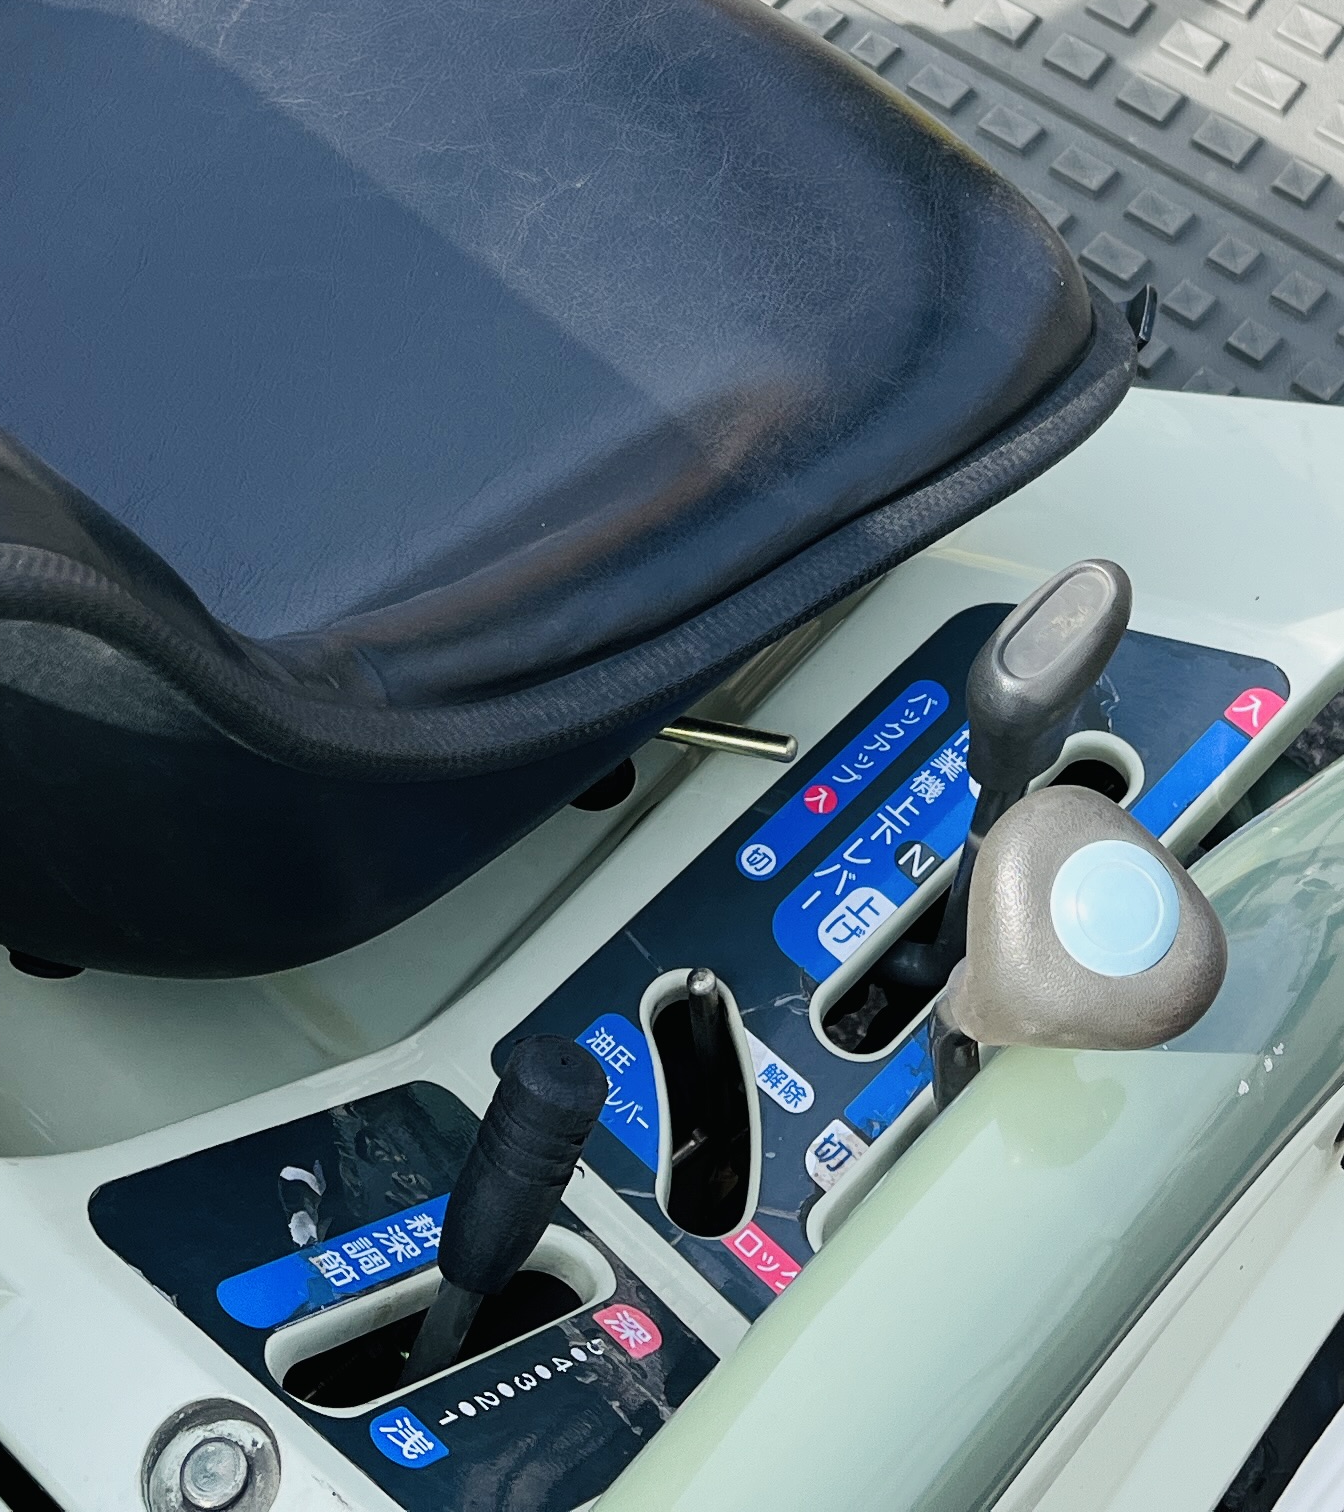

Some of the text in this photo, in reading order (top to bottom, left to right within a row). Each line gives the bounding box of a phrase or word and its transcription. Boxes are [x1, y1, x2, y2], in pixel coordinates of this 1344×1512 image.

[1231, 694, 1262, 728] 入
[832, 693, 939, 784] バックアップ
[803, 787, 828, 814] 入
[746, 847, 773, 872] 切
[897, 843, 935, 879] N
[824, 896, 880, 944] 上げ
[586, 1026, 637, 1074] 油圧
[758, 1062, 807, 1110] 解除
[814, 1132, 853, 1172] 切
[603, 1310, 652, 1350] 深
[513, 1372, 537, 1391] 3
[551, 1356, 574, 1373] 4
[438, 1408, 459, 1426] 1
[473, 1390, 501, 1412] 2
[378, 1415, 436, 1460] 浅
